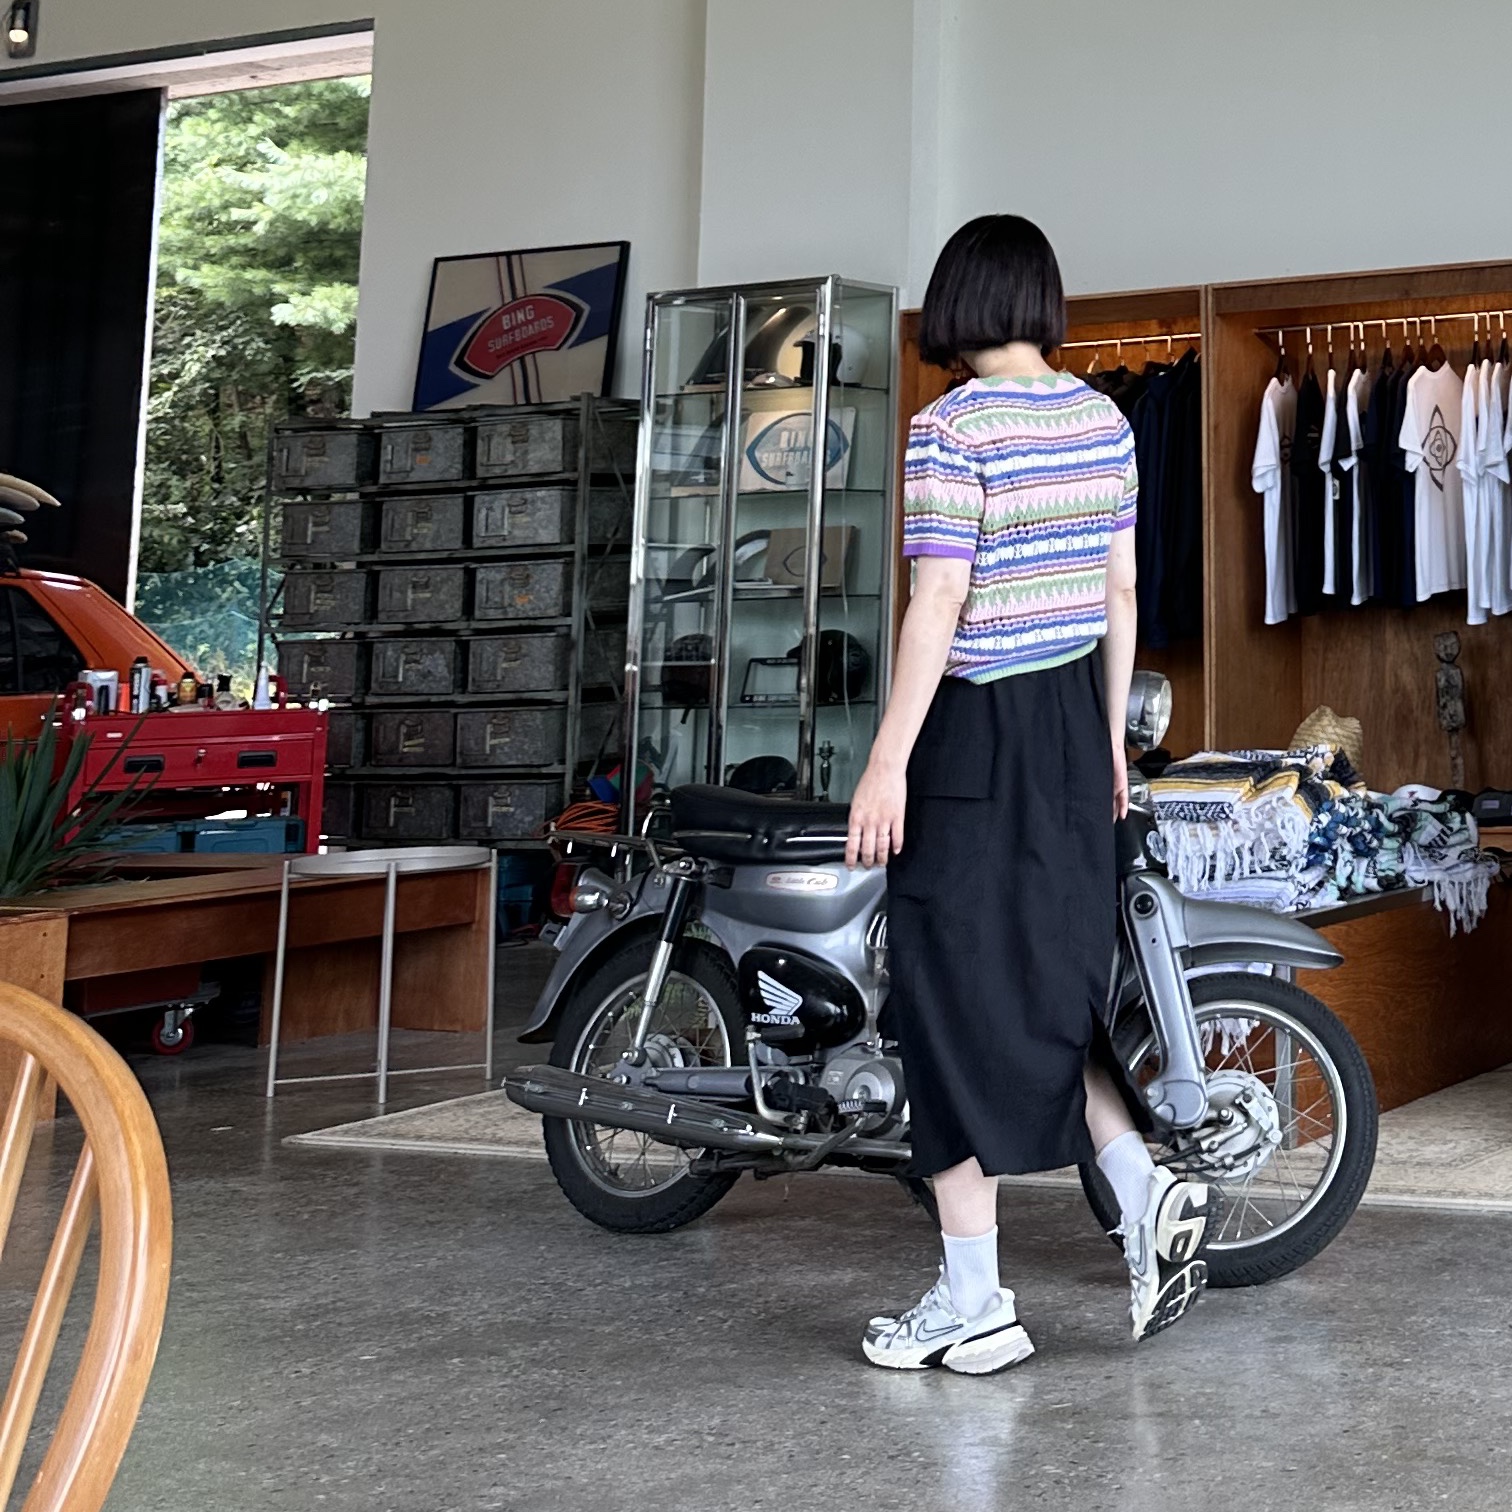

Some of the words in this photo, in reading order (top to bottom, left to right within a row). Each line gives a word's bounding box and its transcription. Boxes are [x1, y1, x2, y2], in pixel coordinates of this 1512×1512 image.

[501, 304, 535, 331] BING
[487, 315, 555, 353] SURFBOARDS
[751, 1012, 800, 1026] HONDA
